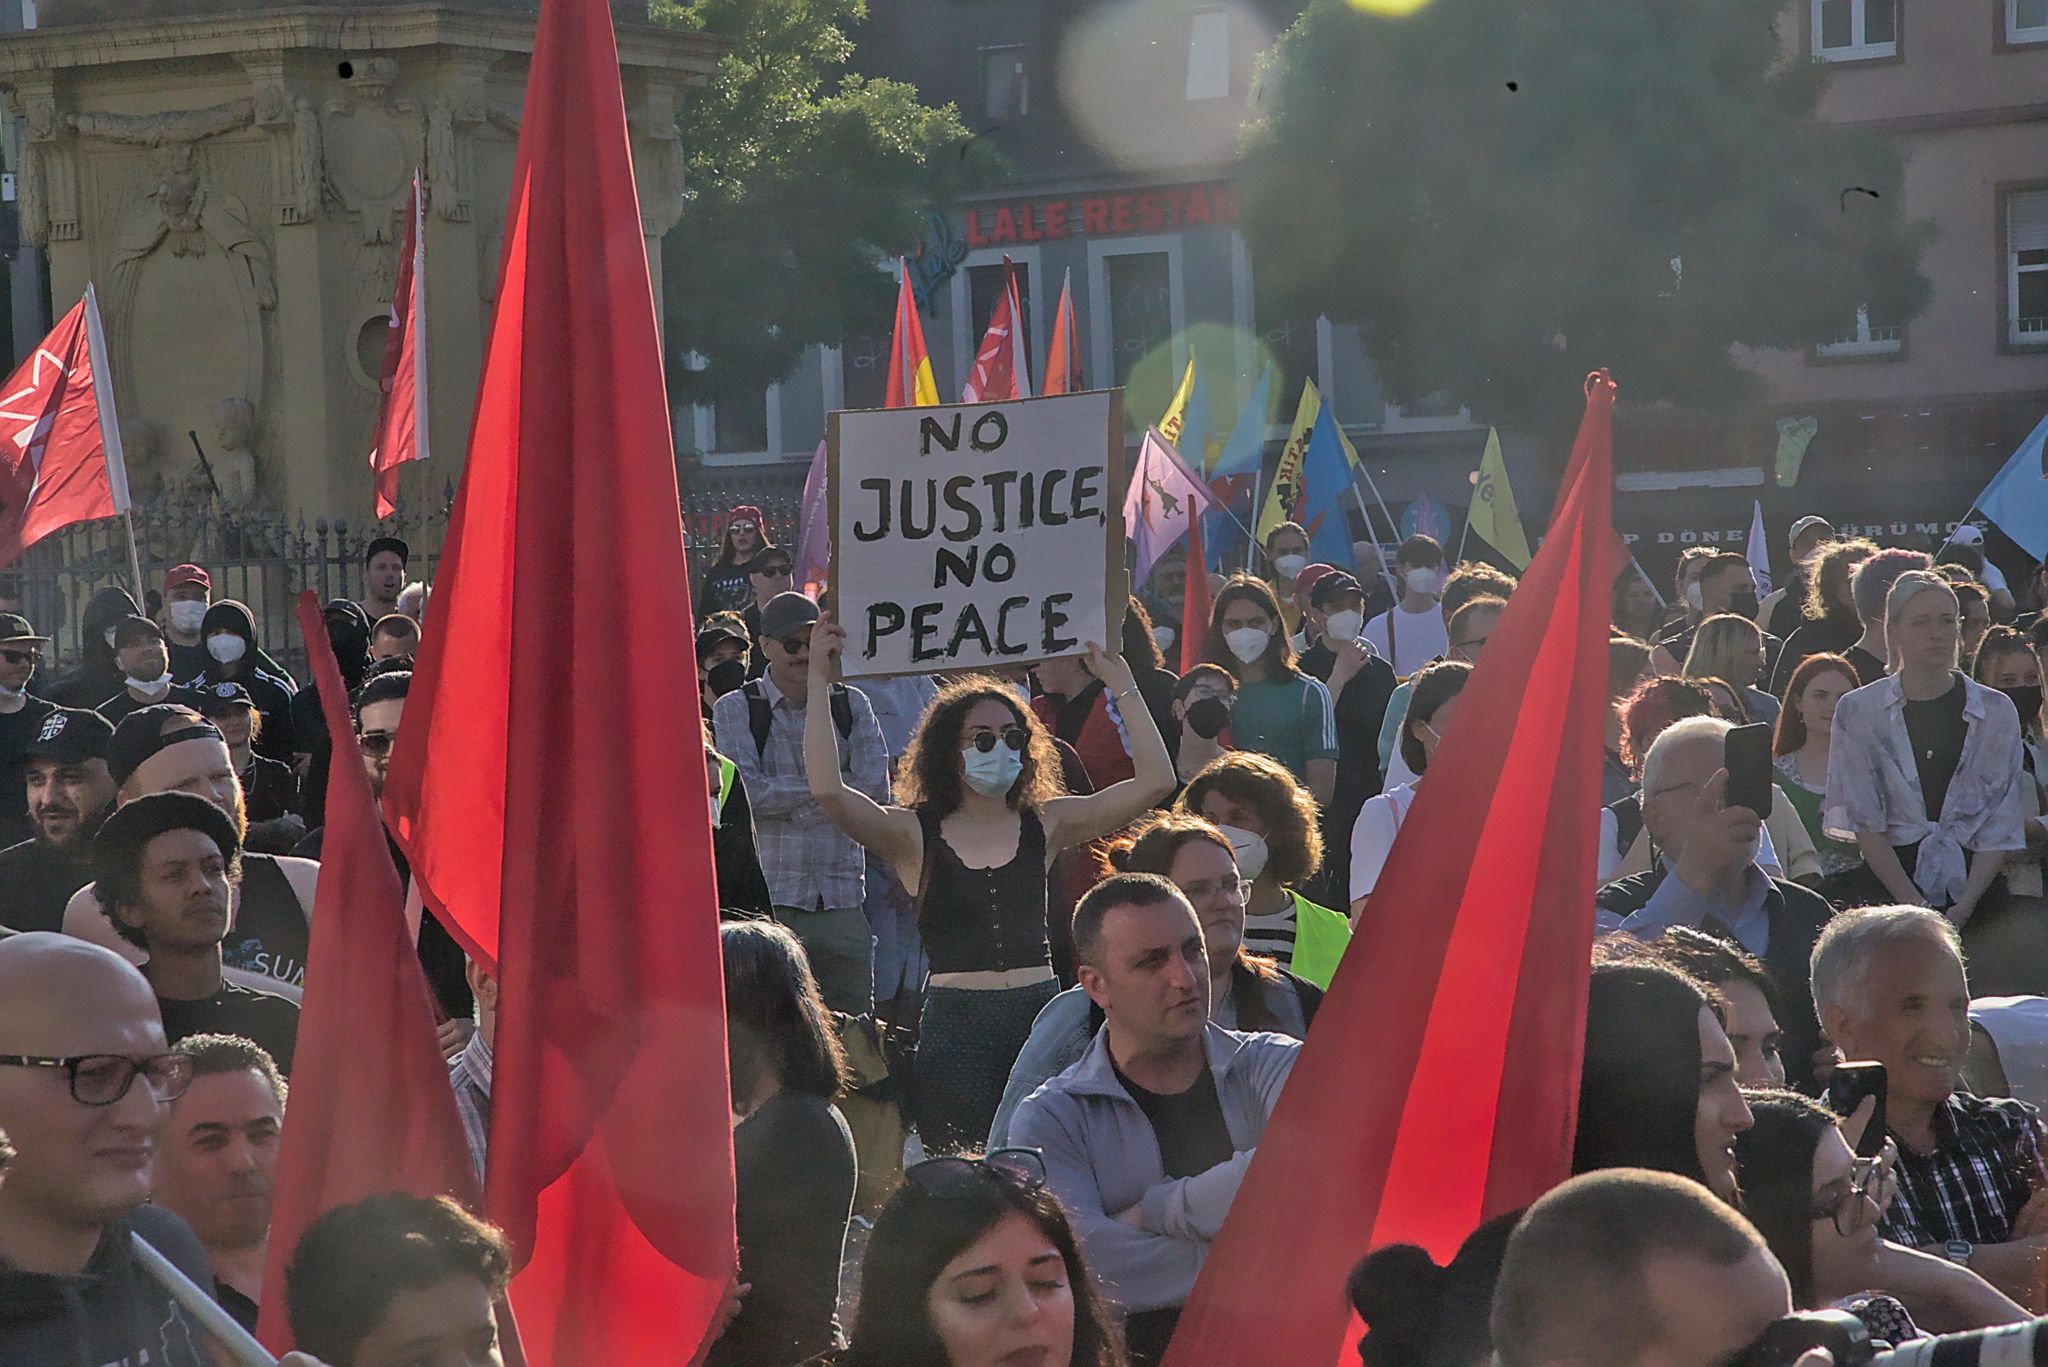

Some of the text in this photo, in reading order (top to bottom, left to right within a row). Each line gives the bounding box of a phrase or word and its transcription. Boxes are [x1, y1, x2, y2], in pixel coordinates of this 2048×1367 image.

[966, 183, 1239, 247] LALE RESTAU
[919, 411, 1008, 456] NO
[853, 466, 1106, 541] JUSTICE,
[1658, 529, 1743, 544] DÖNE
[934, 543, 1015, 588] NO
[862, 592, 1078, 664] PEACE
